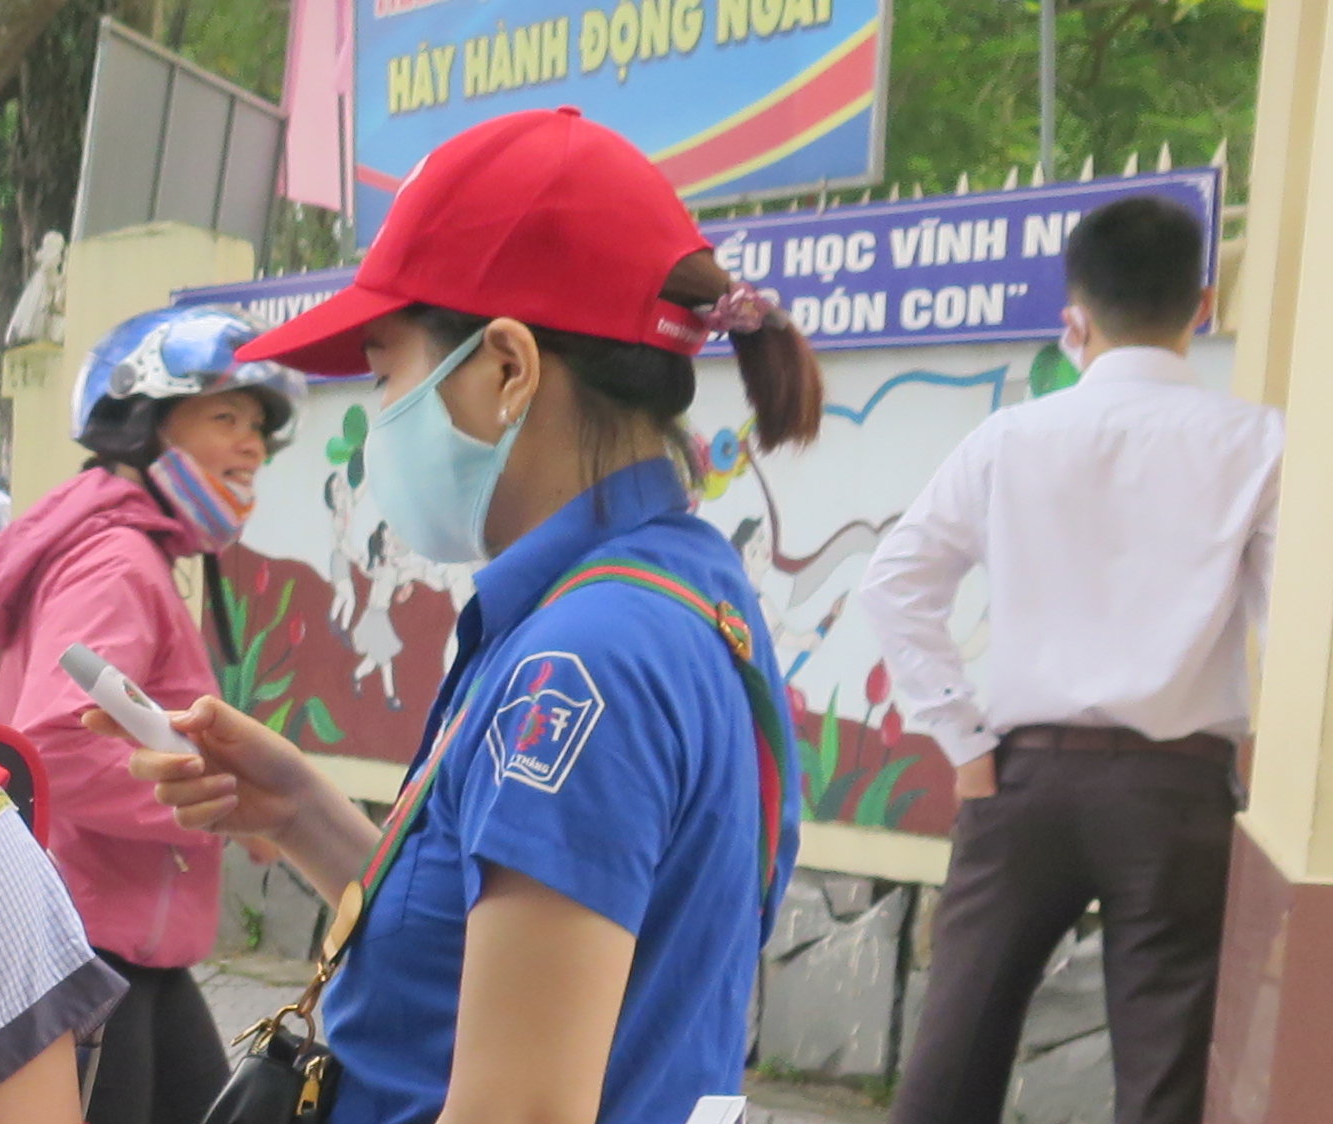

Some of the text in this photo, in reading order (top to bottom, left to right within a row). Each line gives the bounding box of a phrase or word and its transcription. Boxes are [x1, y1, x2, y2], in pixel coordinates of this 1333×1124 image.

[784, 230, 876, 284] HỌC
[890, 216, 1008, 269] VĨNH
[791, 286, 887, 337] ĐÓN
